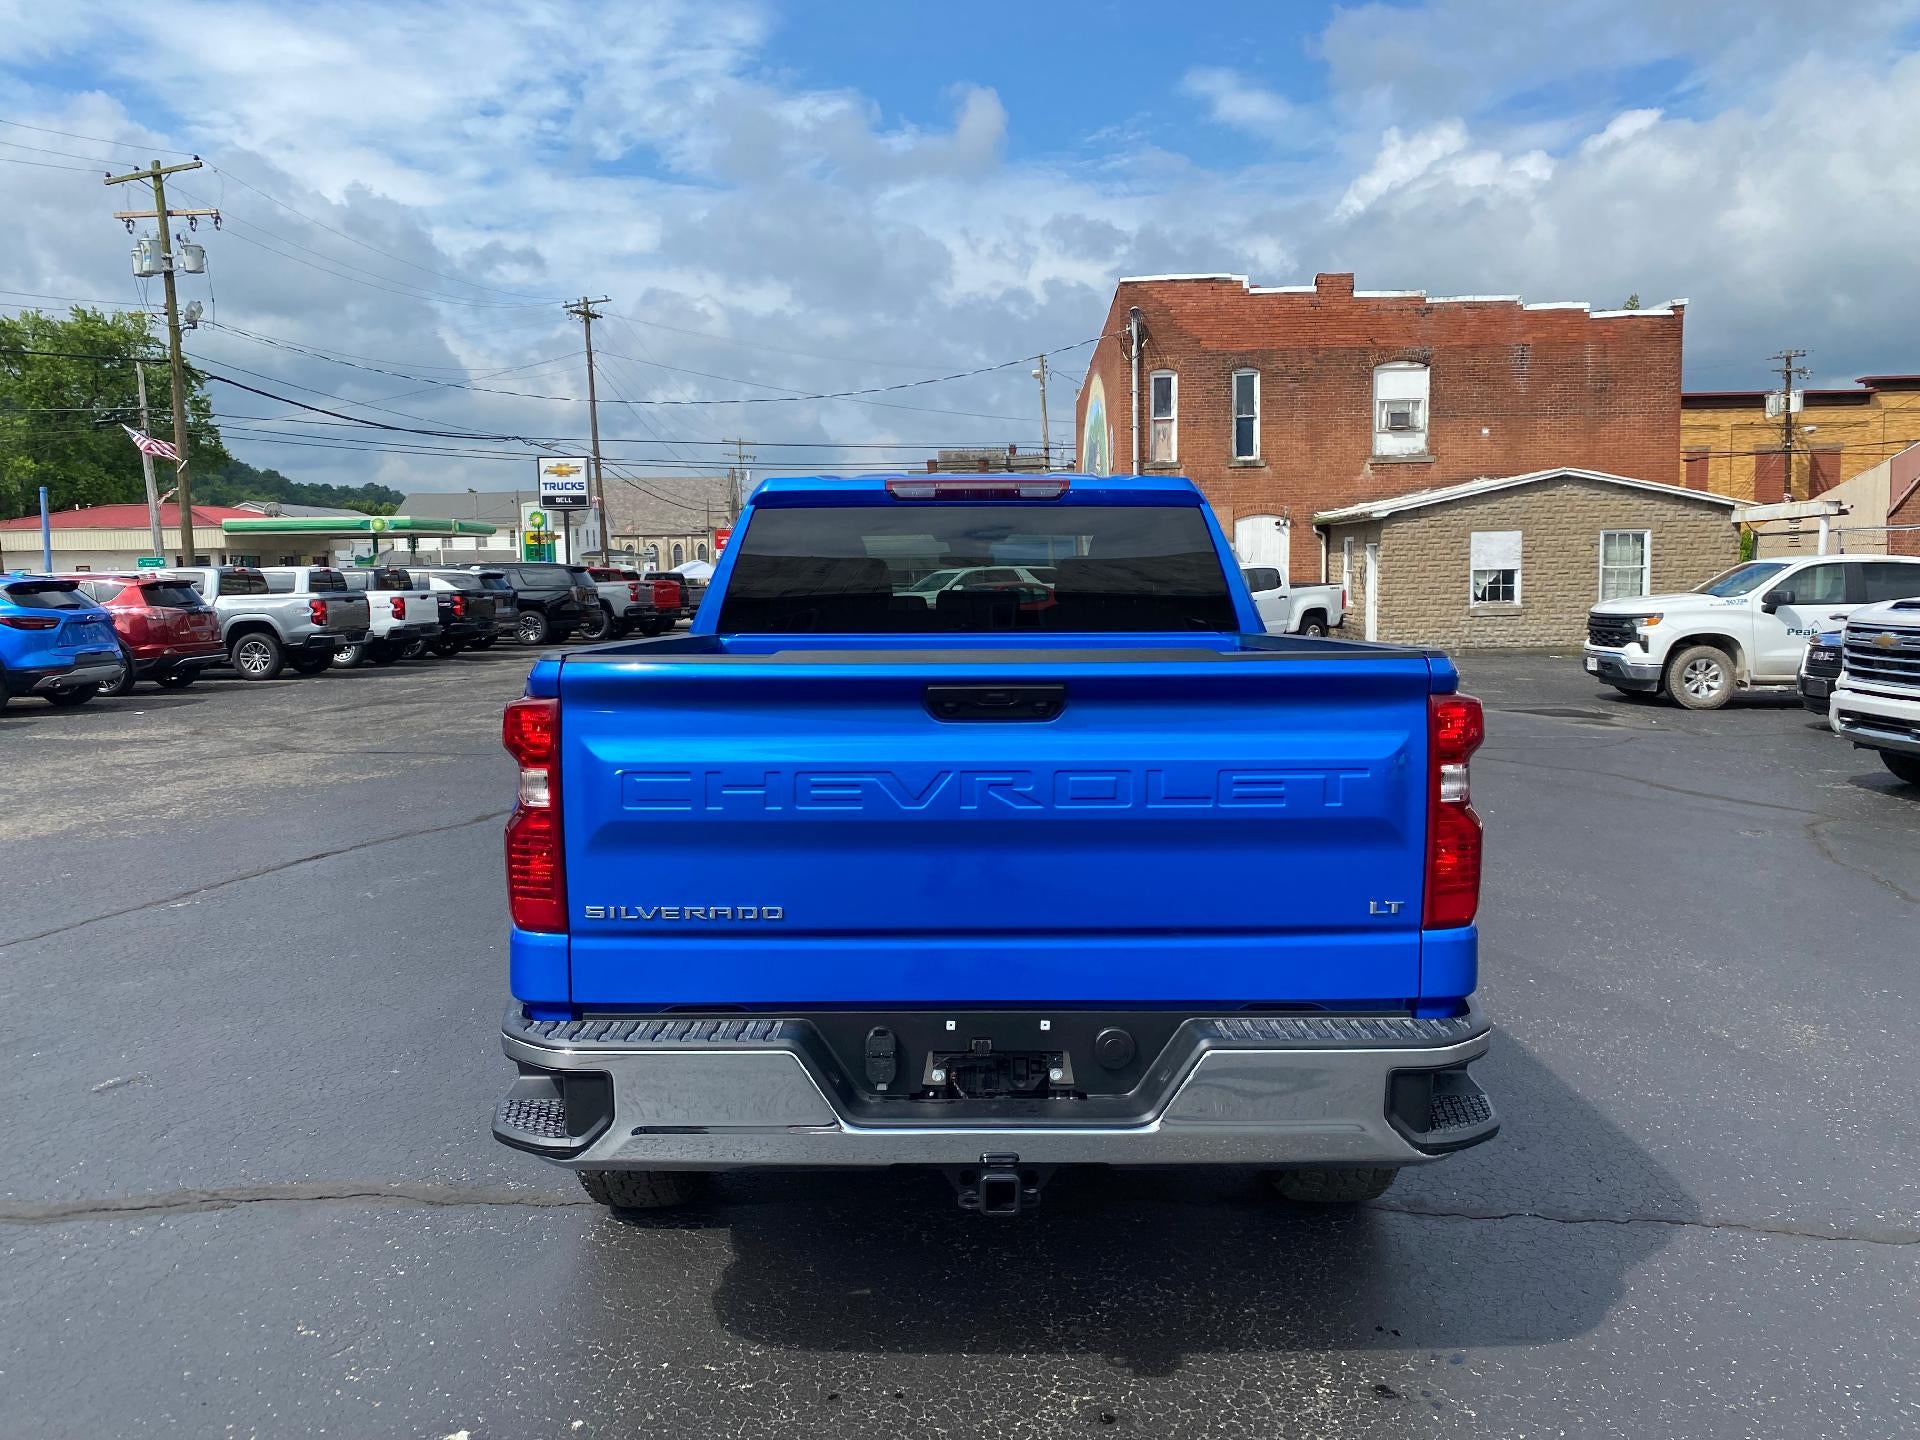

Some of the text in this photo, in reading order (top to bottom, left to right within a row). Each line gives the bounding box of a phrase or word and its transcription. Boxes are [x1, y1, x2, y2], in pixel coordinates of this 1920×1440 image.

[542, 481, 585, 491] TRUCKS
[620, 768, 1371, 810] CHEVROLET
[584, 905, 784, 920] SILVERADO
[1369, 900, 1405, 914] LT
